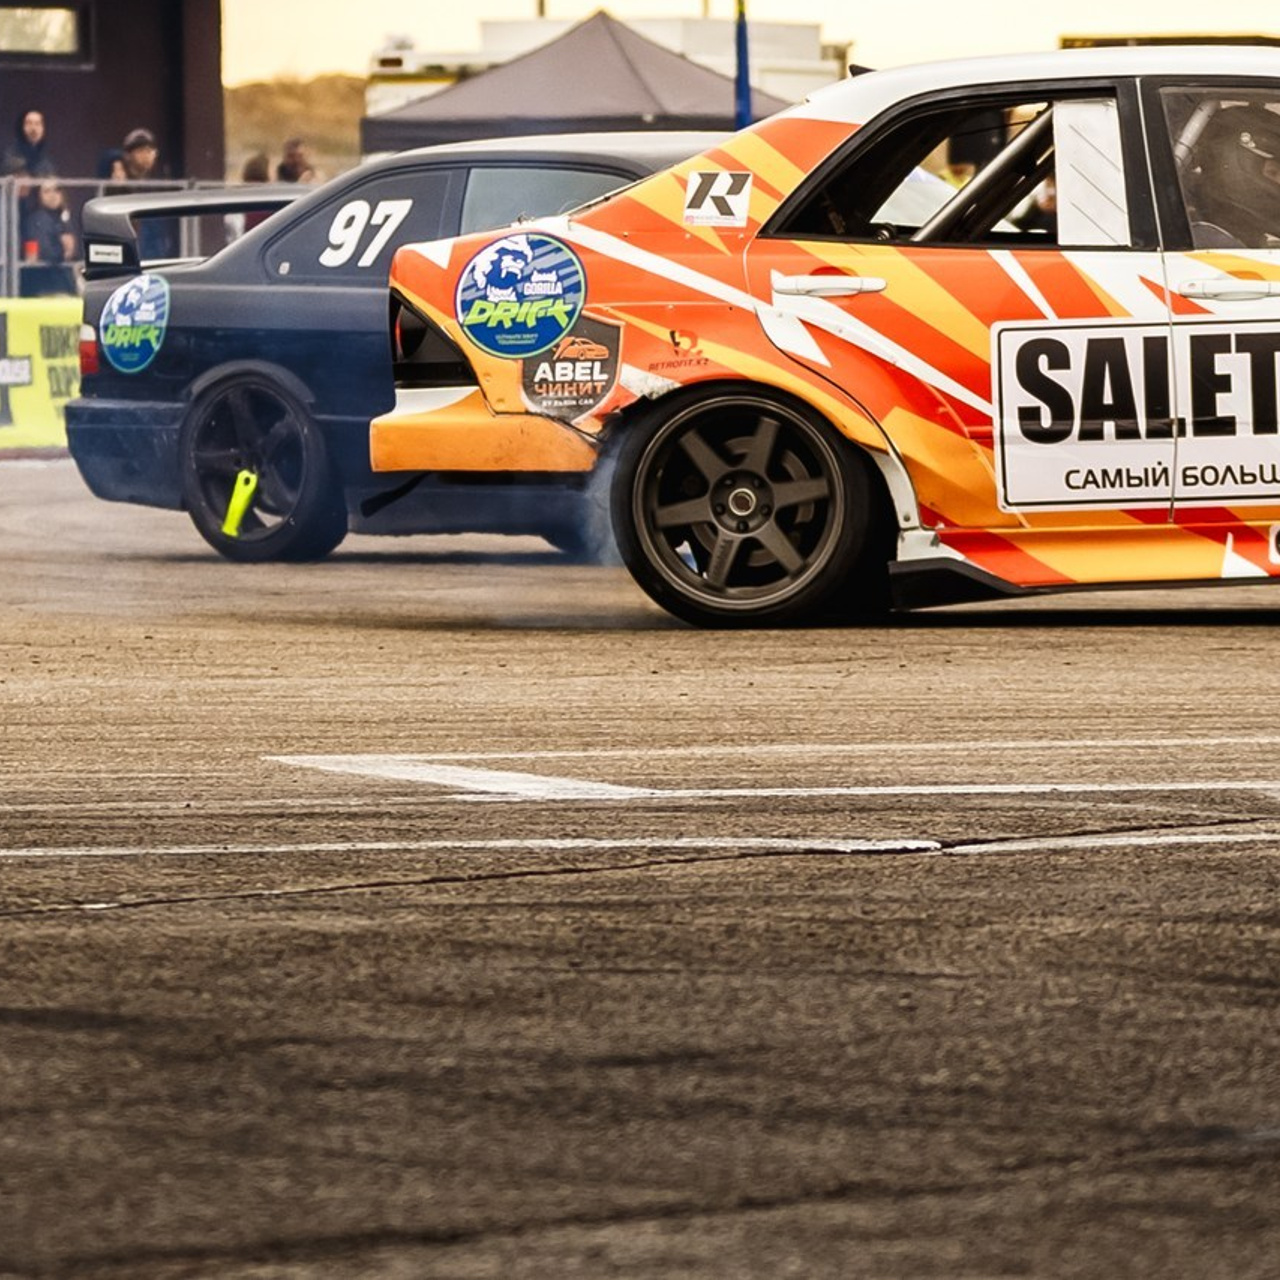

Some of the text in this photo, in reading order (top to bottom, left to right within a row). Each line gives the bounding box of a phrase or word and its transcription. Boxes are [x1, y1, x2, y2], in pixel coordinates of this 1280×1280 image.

[319, 199, 413, 267] 97
[463, 299, 573, 329] DRIFT
[533, 361, 609, 382] ABEL
[1065, 461, 1170, 490] САМЫЙ
